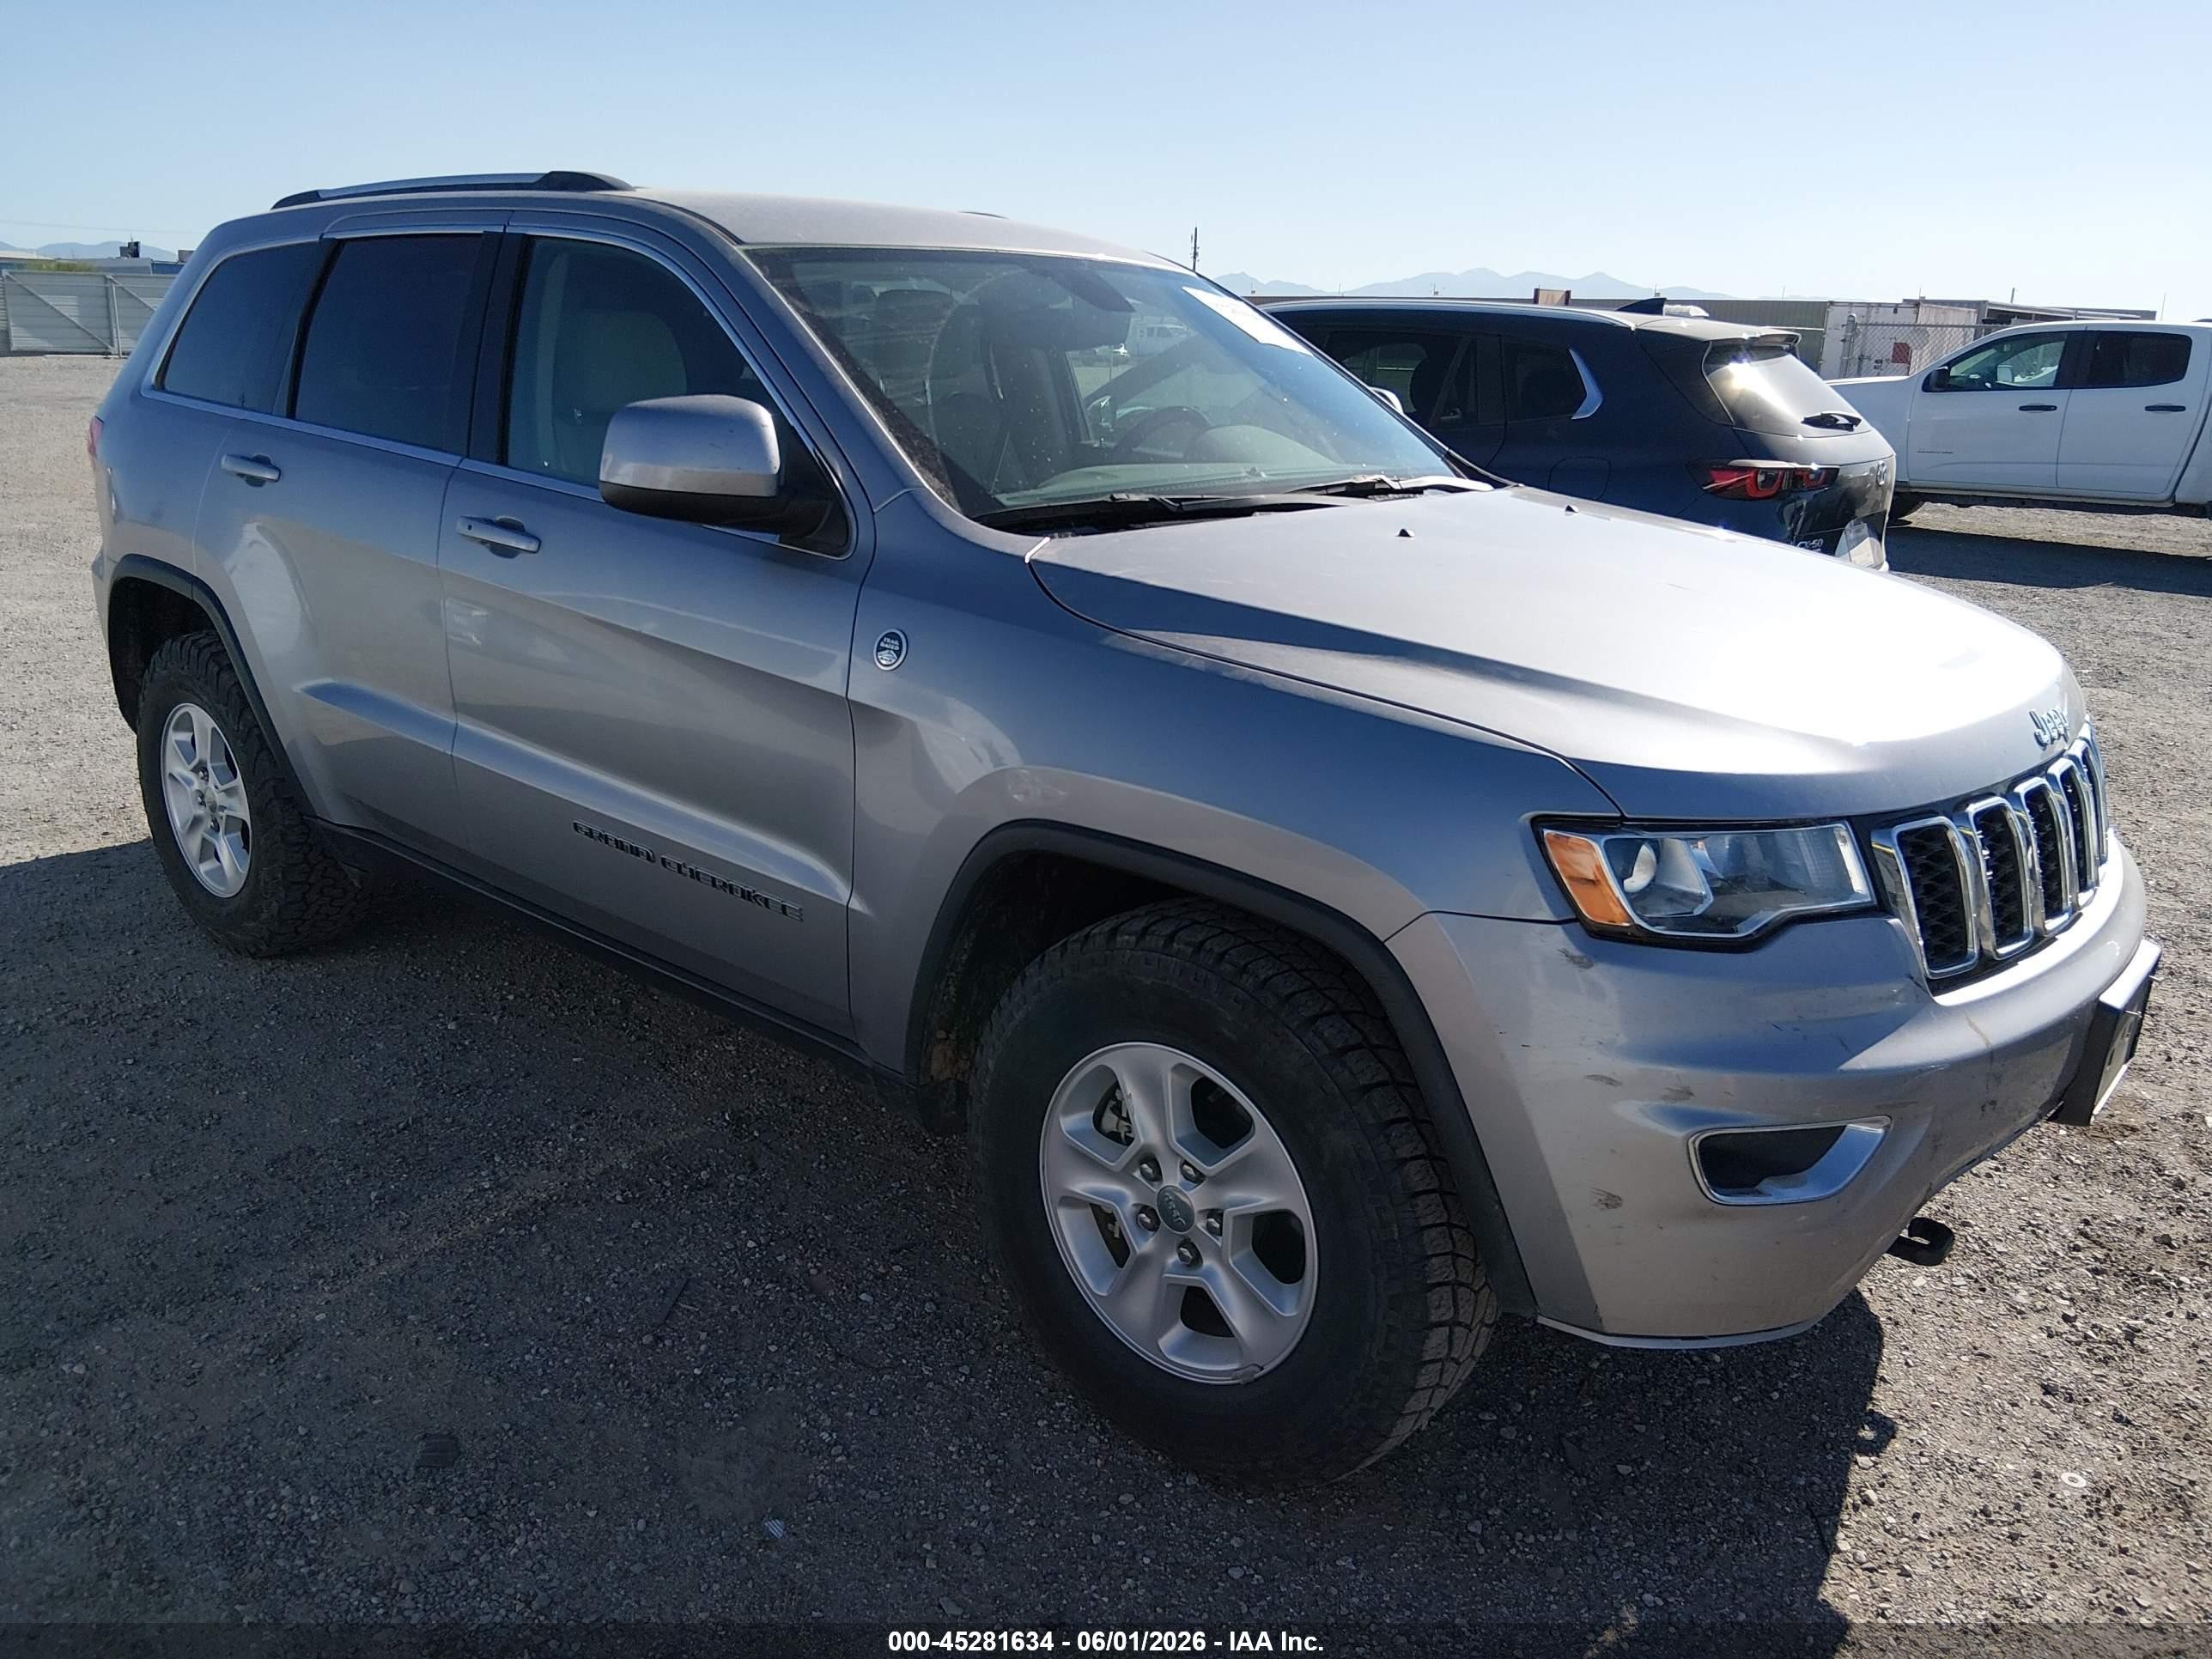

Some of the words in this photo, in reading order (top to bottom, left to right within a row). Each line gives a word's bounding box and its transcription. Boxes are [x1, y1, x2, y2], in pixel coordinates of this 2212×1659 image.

[2028, 707, 2069, 751] Jeep
[572, 820, 657, 864] GRAND
[659, 854, 804, 922] CHEROKEE
